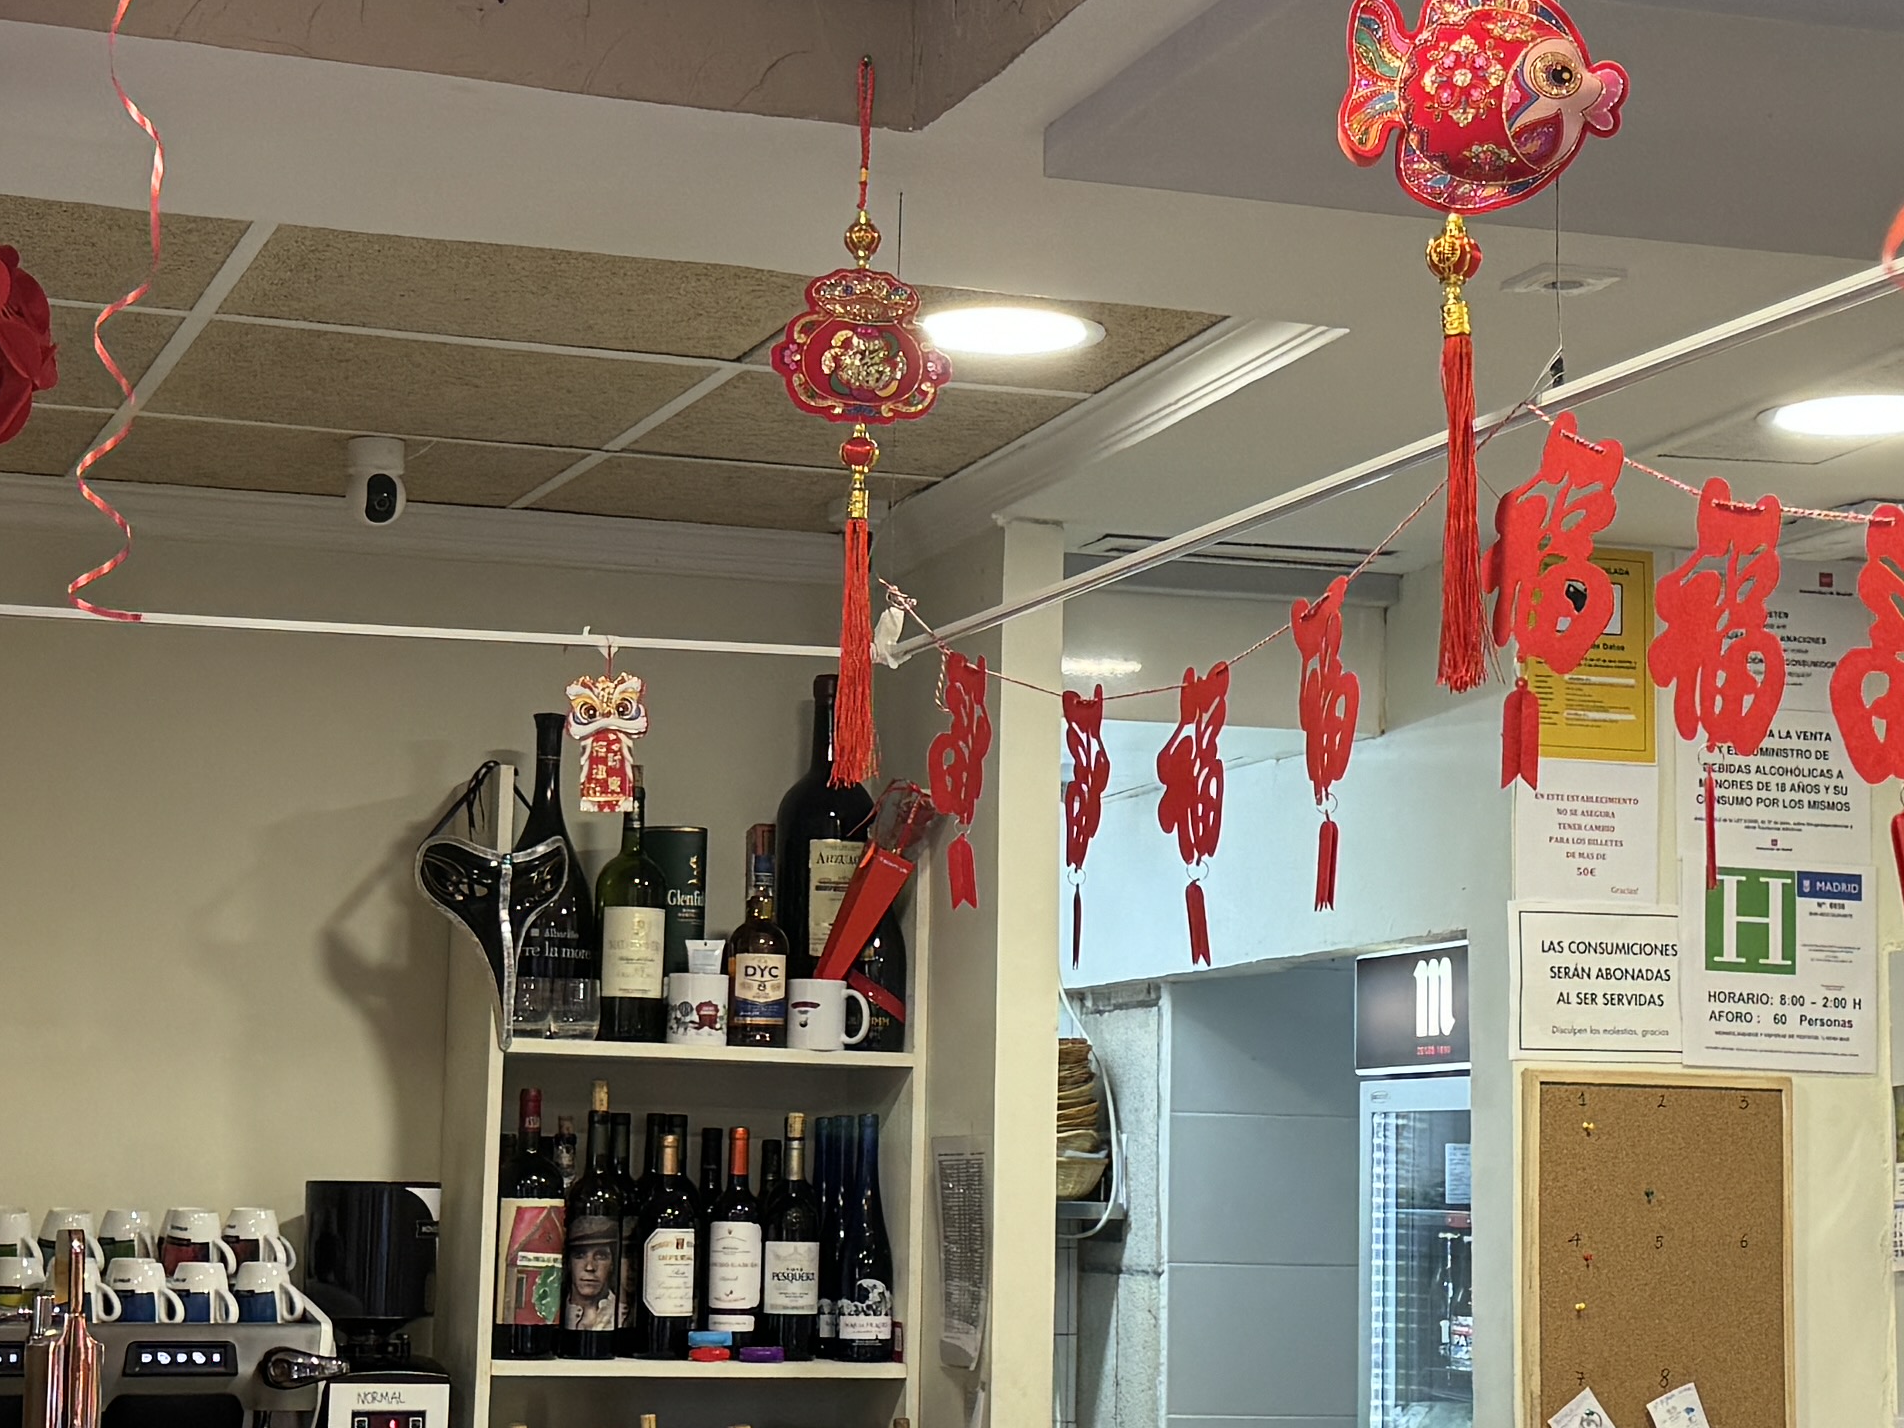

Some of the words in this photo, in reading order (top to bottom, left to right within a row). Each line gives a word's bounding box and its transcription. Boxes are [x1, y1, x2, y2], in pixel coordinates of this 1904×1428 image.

[1778, 730, 1793, 741] LA
[1795, 730, 1832, 742] VENTA
[1814, 750, 1829, 760] DE
[1755, 764, 1834, 779] ALCOHÓLICAS
[1836, 769, 1844, 779] A
[1756, 781, 1772, 792] DE
[1775, 782, 1786, 793] 18
[1789, 781, 1821, 795] AÑOS
[1823, 785, 1830, 794] Y
[1833, 785, 1848, 796] SU
[1535, 792, 1545, 800] EN
[1546, 793, 1565, 802] ESTE
[1567, 794, 1639, 805] ESTABLECIMIENTO
[1696, 794, 1753, 807] CNSUMO
[1756, 797, 1779, 809] POR
[1782, 798, 1805, 810] LOS
[1807, 799, 1851, 812] MISMOS
[1557, 808, 1568, 816] NO
[1580, 810, 1615, 818] ASEGURA
[1558, 822, 1583, 831] TENER
[1584, 824, 1615, 832] CAMBIO
[1549, 836, 1569, 844] PARA
[1572, 837, 1586, 845] LOS
[1588, 838, 1624, 847] BILLETES
[1566, 851, 1576, 859] DE
[1576, 867, 1596, 877] 50€
[1816, 880, 1859, 894] MADRID
[1713, 874, 1792, 965] H
[1541, 939, 1564, 954] LAS
[1568, 940, 1678, 957] CONSUMICIONES
[745, 965, 779, 979] DYC
[1550, 962, 1591, 980] SERÁN
[1596, 967, 1671, 982] ABONADAS
[1556, 991, 1572, 1005] AL
[1576, 992, 1598, 1006] SER
[1602, 993, 1664, 1007] SERVIDAS
[1708, 990, 1774, 1006] HORARIO:
[1779, 994, 1805, 1007] 8:00
[1822, 996, 1847, 1009] 2:00
[1853, 998, 1862, 1010] H
[1773, 1014, 1787, 1025] 60
[1800, 1015, 1854, 1028] Personas
[1551, 1025, 1588, 1037] Disculpen
[1642, 1028, 1669, 1037] gracias
[1578, 1092, 1588, 1107] 1
[1657, 1095, 1667, 1109] 2
[1739, 1096, 1750, 1110] 3
[1568, 1233, 1583, 1249] 4
[1655, 1235, 1664, 1250] 5
[1739, 1235, 1749, 1249] 6
[1576, 1371, 1586, 1386] 7
[1659, 1368, 1670, 1387] 8
[357, 1391, 406, 1405] NORMAL
